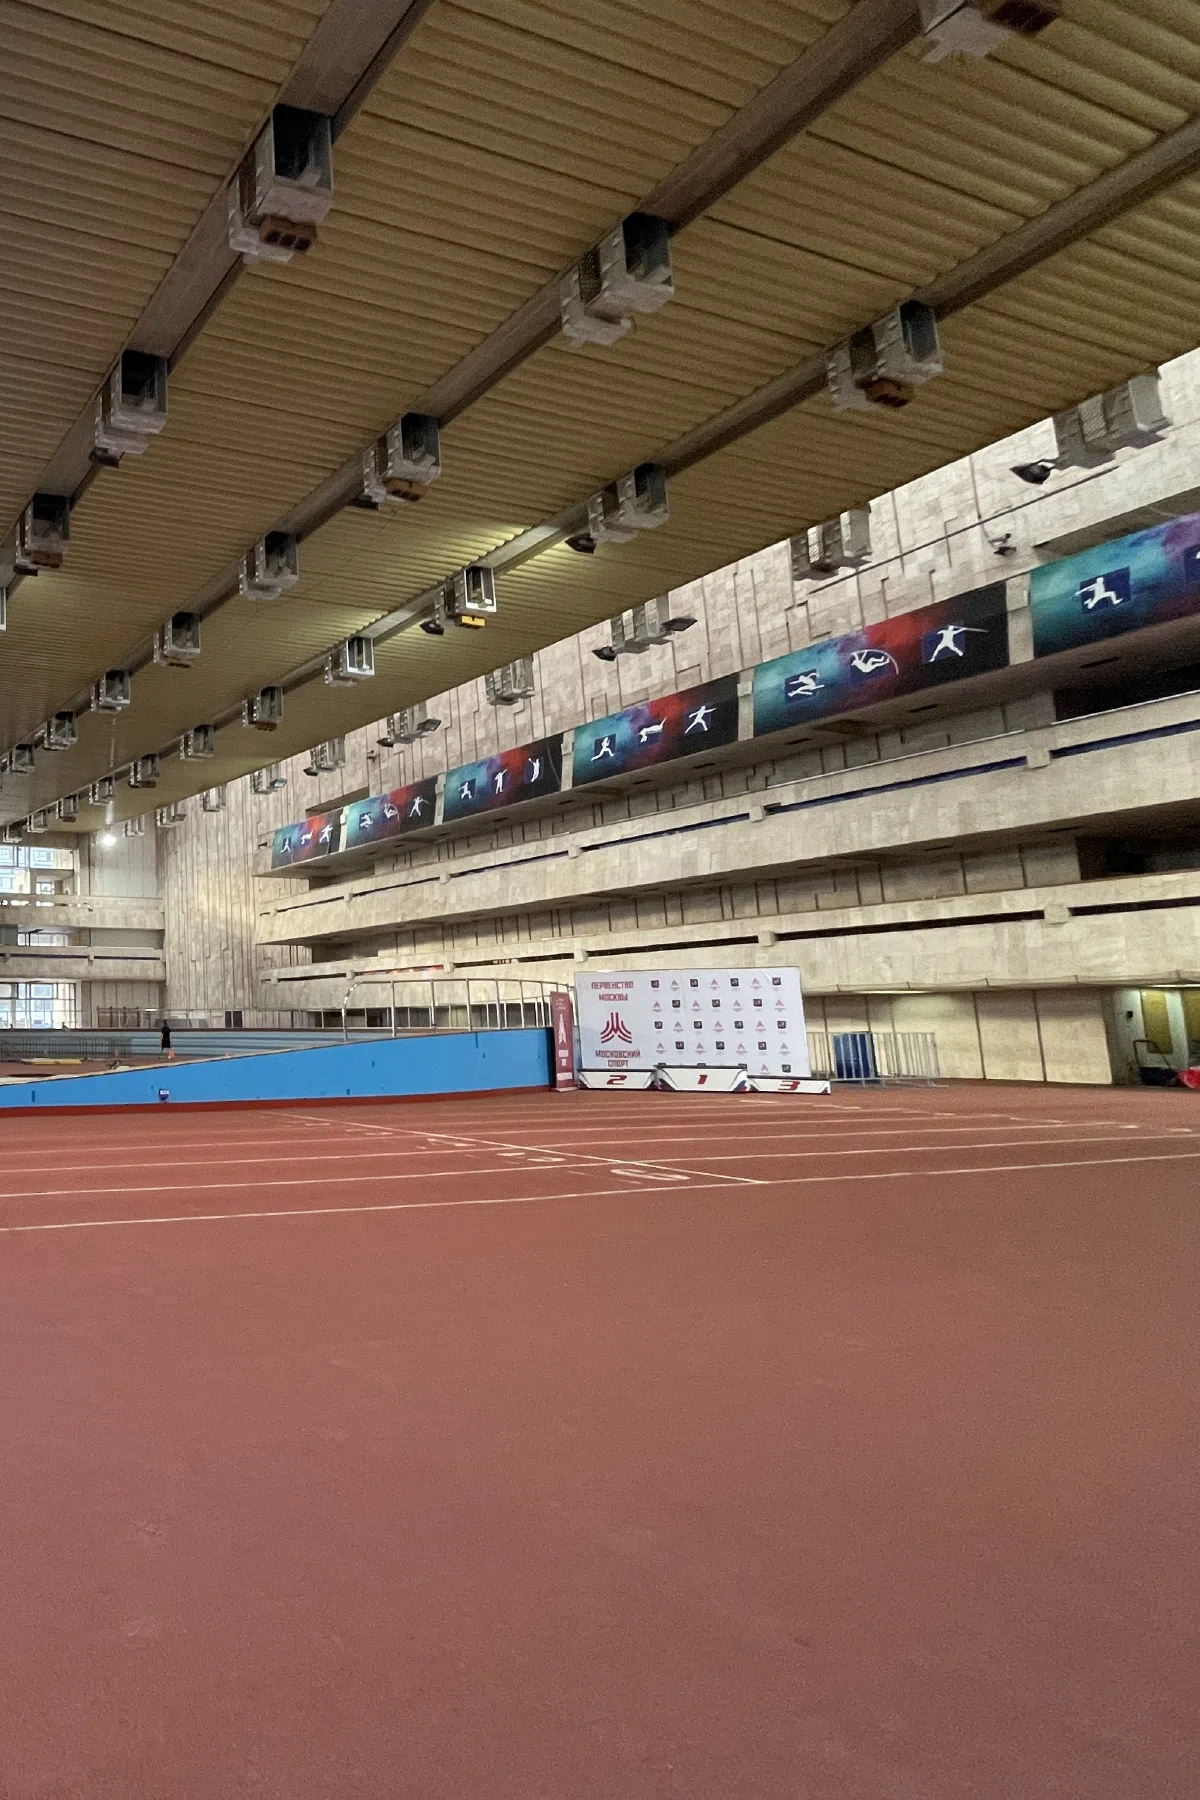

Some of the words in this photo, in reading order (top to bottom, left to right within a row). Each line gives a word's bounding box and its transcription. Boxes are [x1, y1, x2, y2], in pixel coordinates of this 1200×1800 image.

[591, 981, 634, 989] ПЕРВЕНСТВО
[598, 993, 628, 1001] МОСКВЫ
[595, 1049, 641, 1058] МОСКОВСКИЙ
[607, 1059, 629, 1068] СПОРТ
[606, 1074, 628, 1086] 2
[697, 1074, 708, 1085] 1
[777, 1080, 801, 1092] 3
